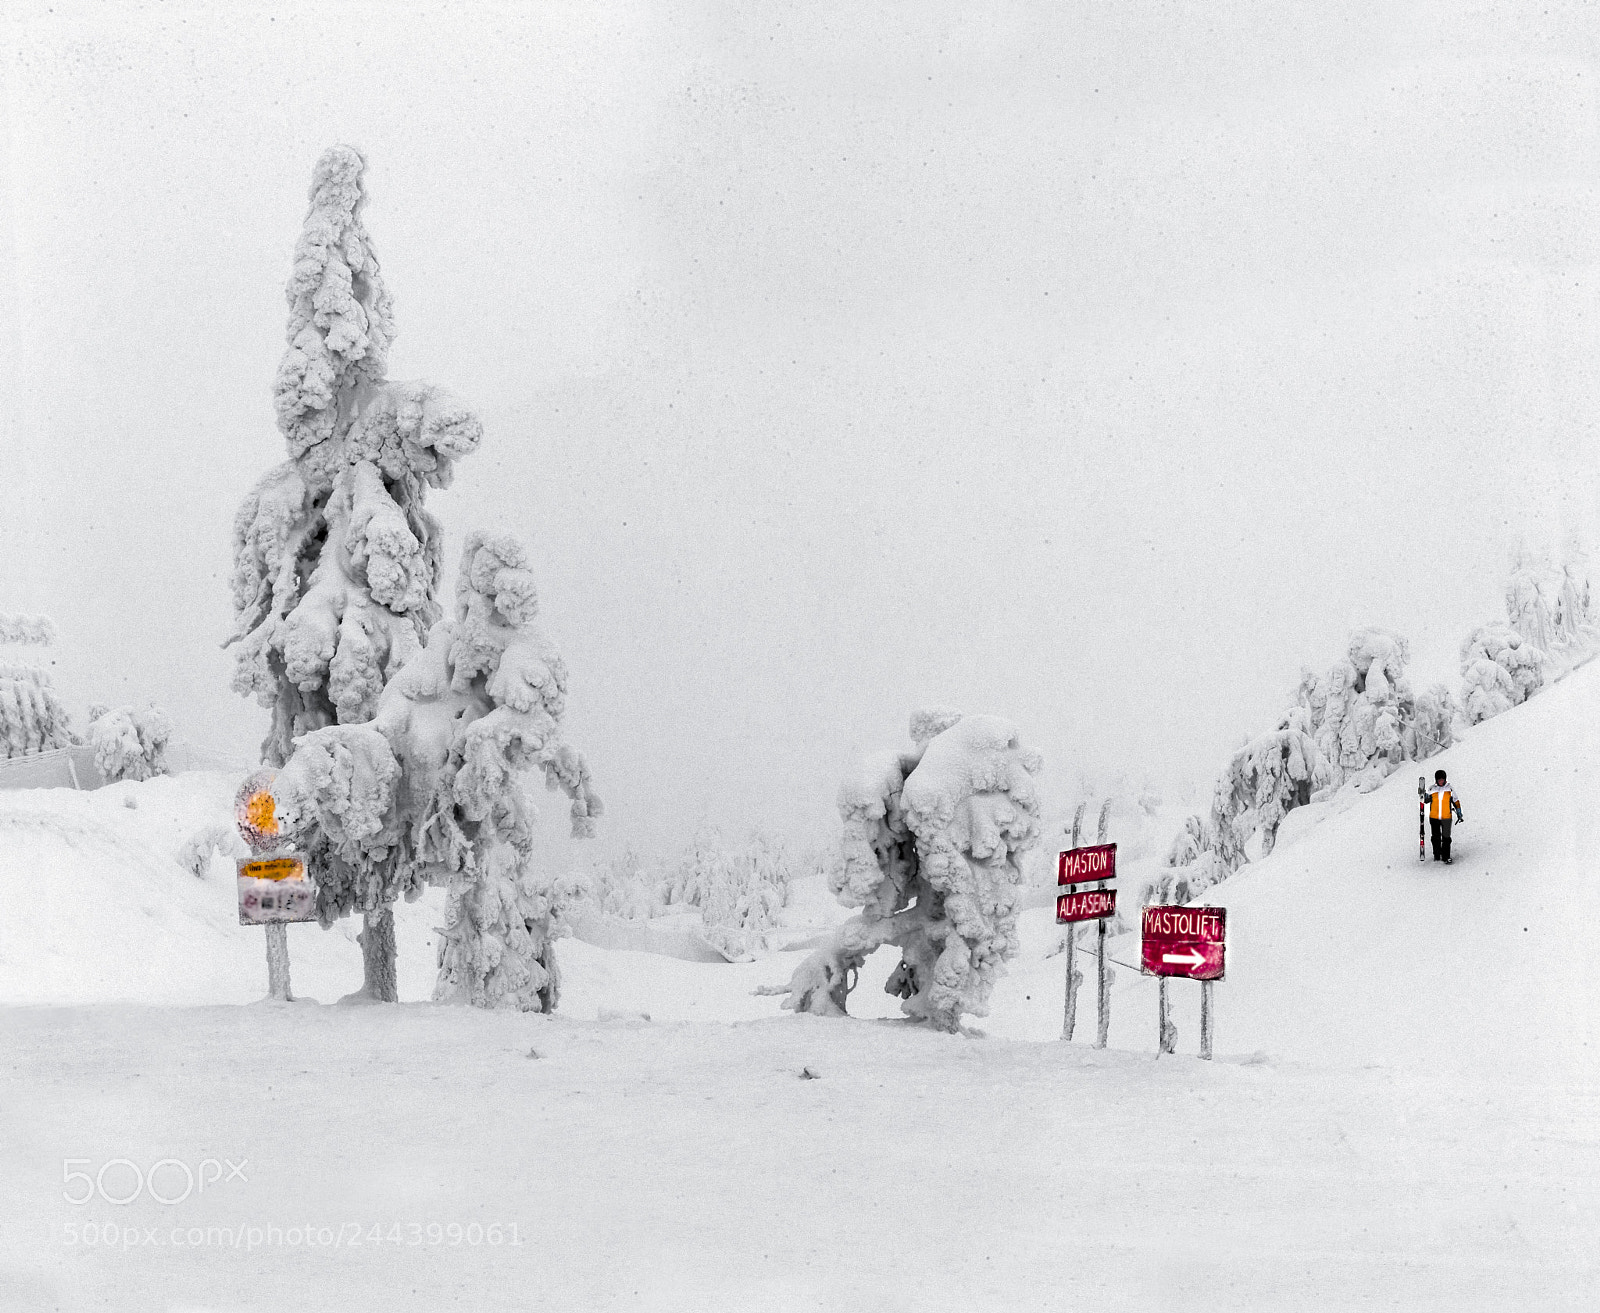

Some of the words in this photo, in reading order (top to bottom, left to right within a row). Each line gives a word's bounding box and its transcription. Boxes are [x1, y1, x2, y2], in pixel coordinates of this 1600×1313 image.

[1065, 851, 1107, 878] MASTON
[1060, 893, 1113, 917] ALA-ASEMA
[1144, 912, 1219, 936] MASTOLIFT
